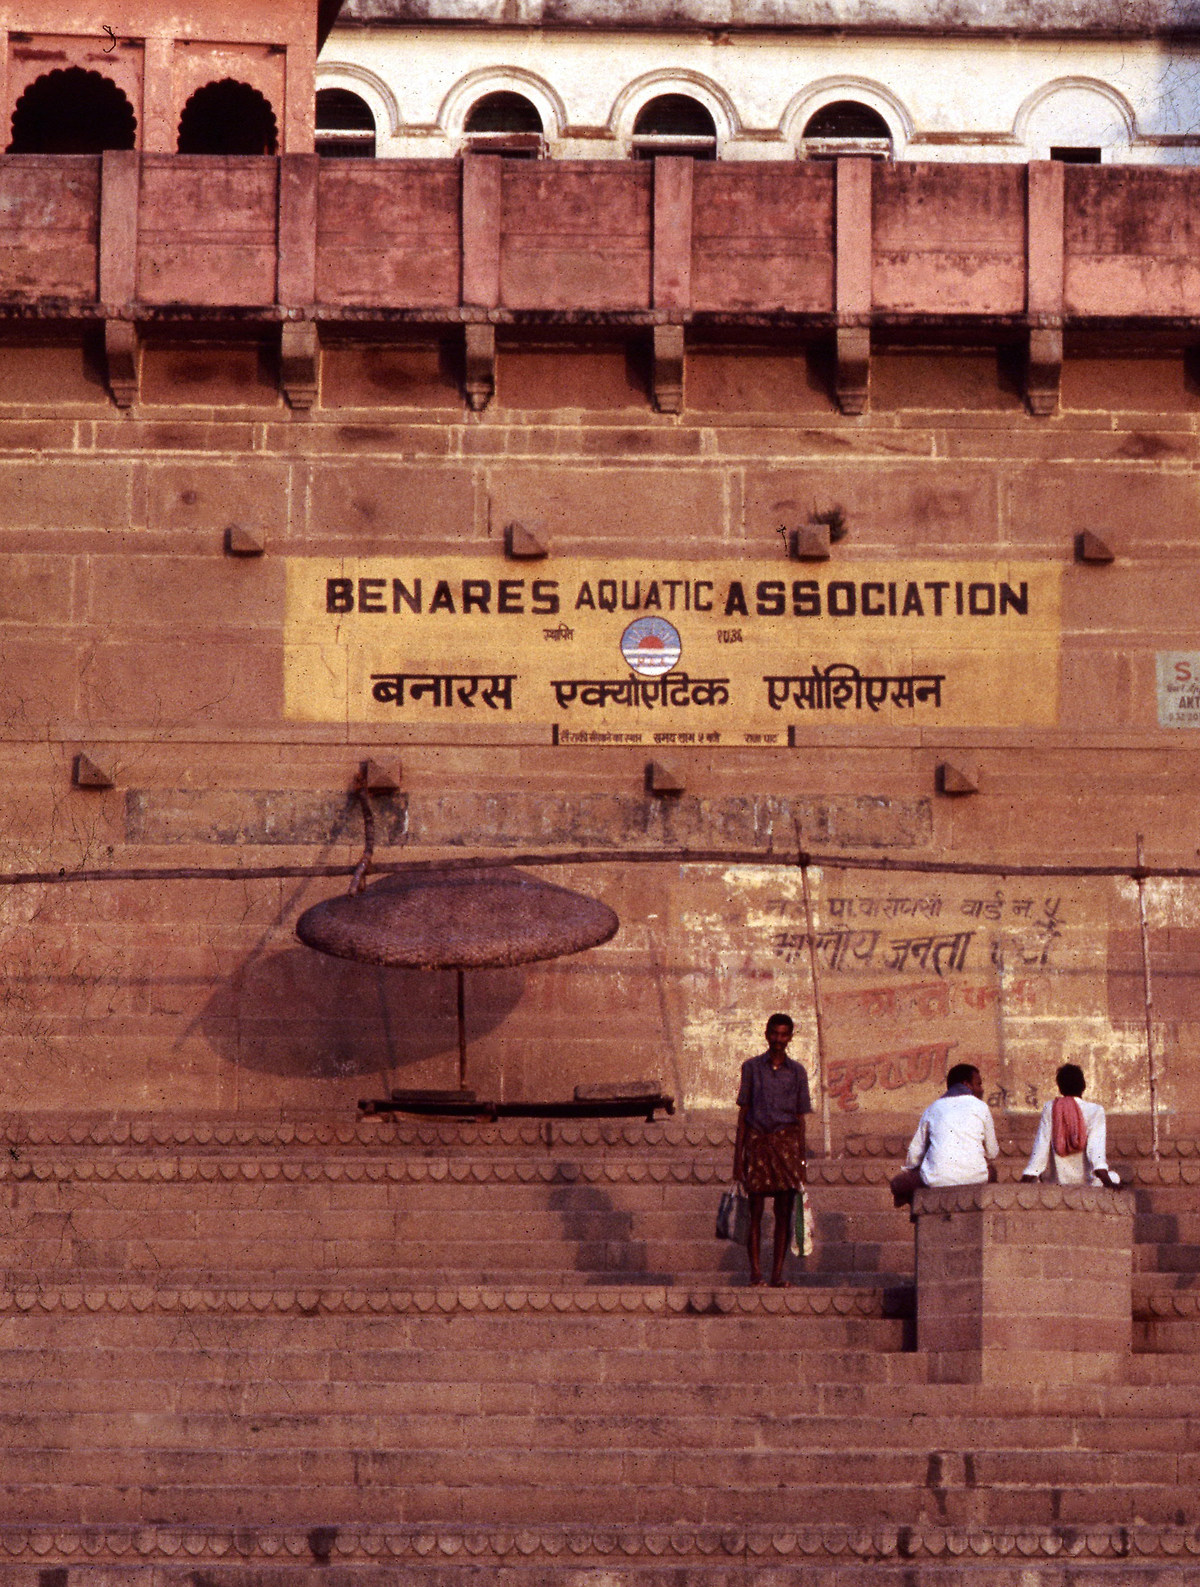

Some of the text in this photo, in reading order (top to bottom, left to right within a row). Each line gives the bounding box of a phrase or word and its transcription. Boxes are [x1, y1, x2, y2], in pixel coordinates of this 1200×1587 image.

[326, 578, 1029, 617] BENARES AQUATIC ASSOCIATION
[370, 673, 518, 710] बनारस
[882, 930, 977, 977] जनता
